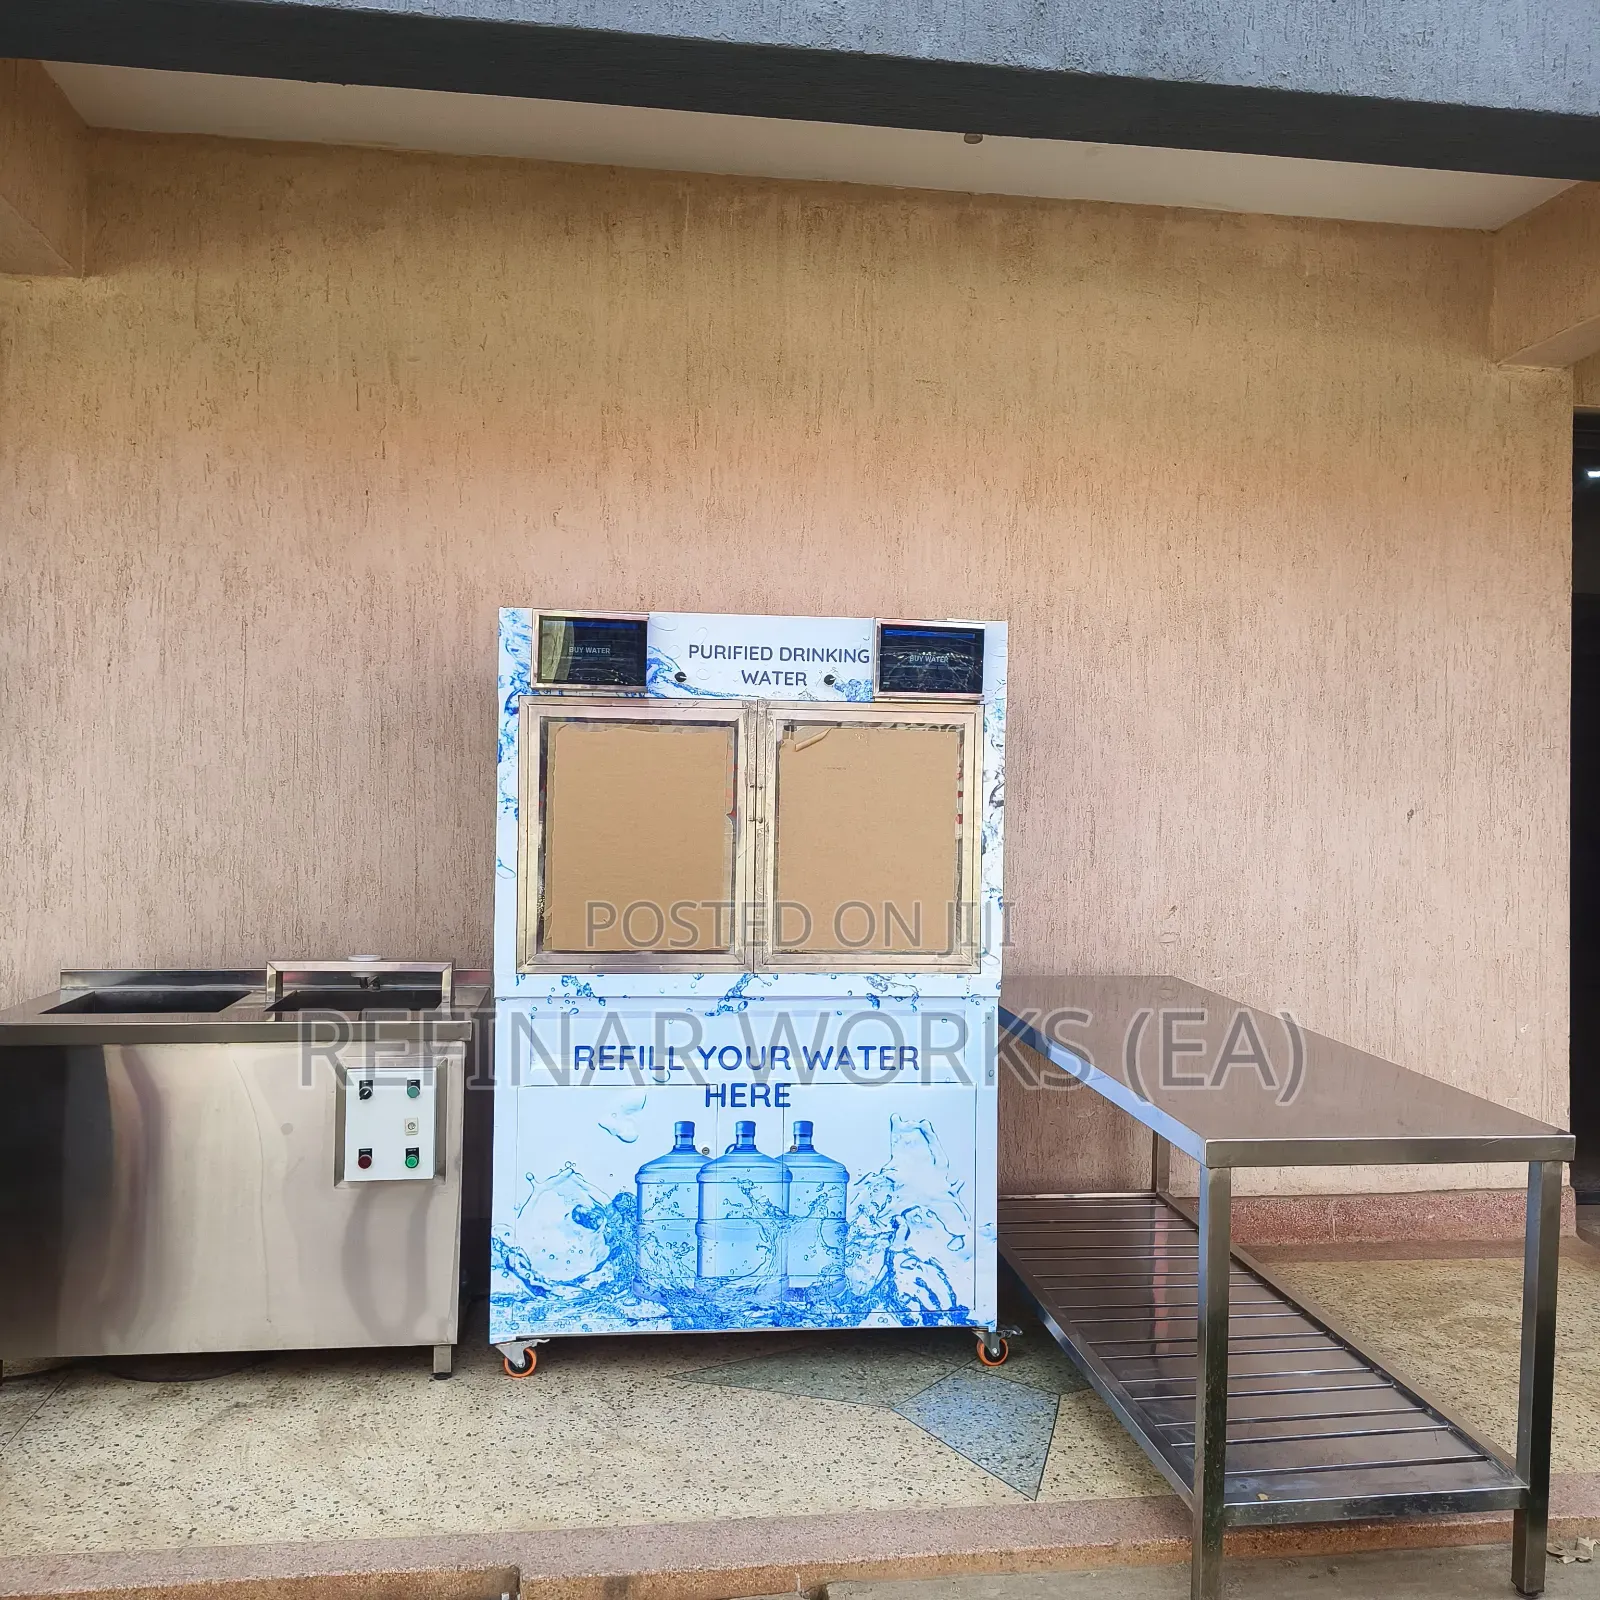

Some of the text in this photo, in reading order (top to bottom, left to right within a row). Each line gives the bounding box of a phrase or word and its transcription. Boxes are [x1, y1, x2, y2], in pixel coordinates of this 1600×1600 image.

[569, 646, 584, 654] BUY
[689, 644, 870, 664] PURIFIED DRINKING
[741, 669, 807, 686] WATER
[573, 1045, 920, 1071] REFILL YOUR WATER
[705, 1083, 792, 1108] HERE
